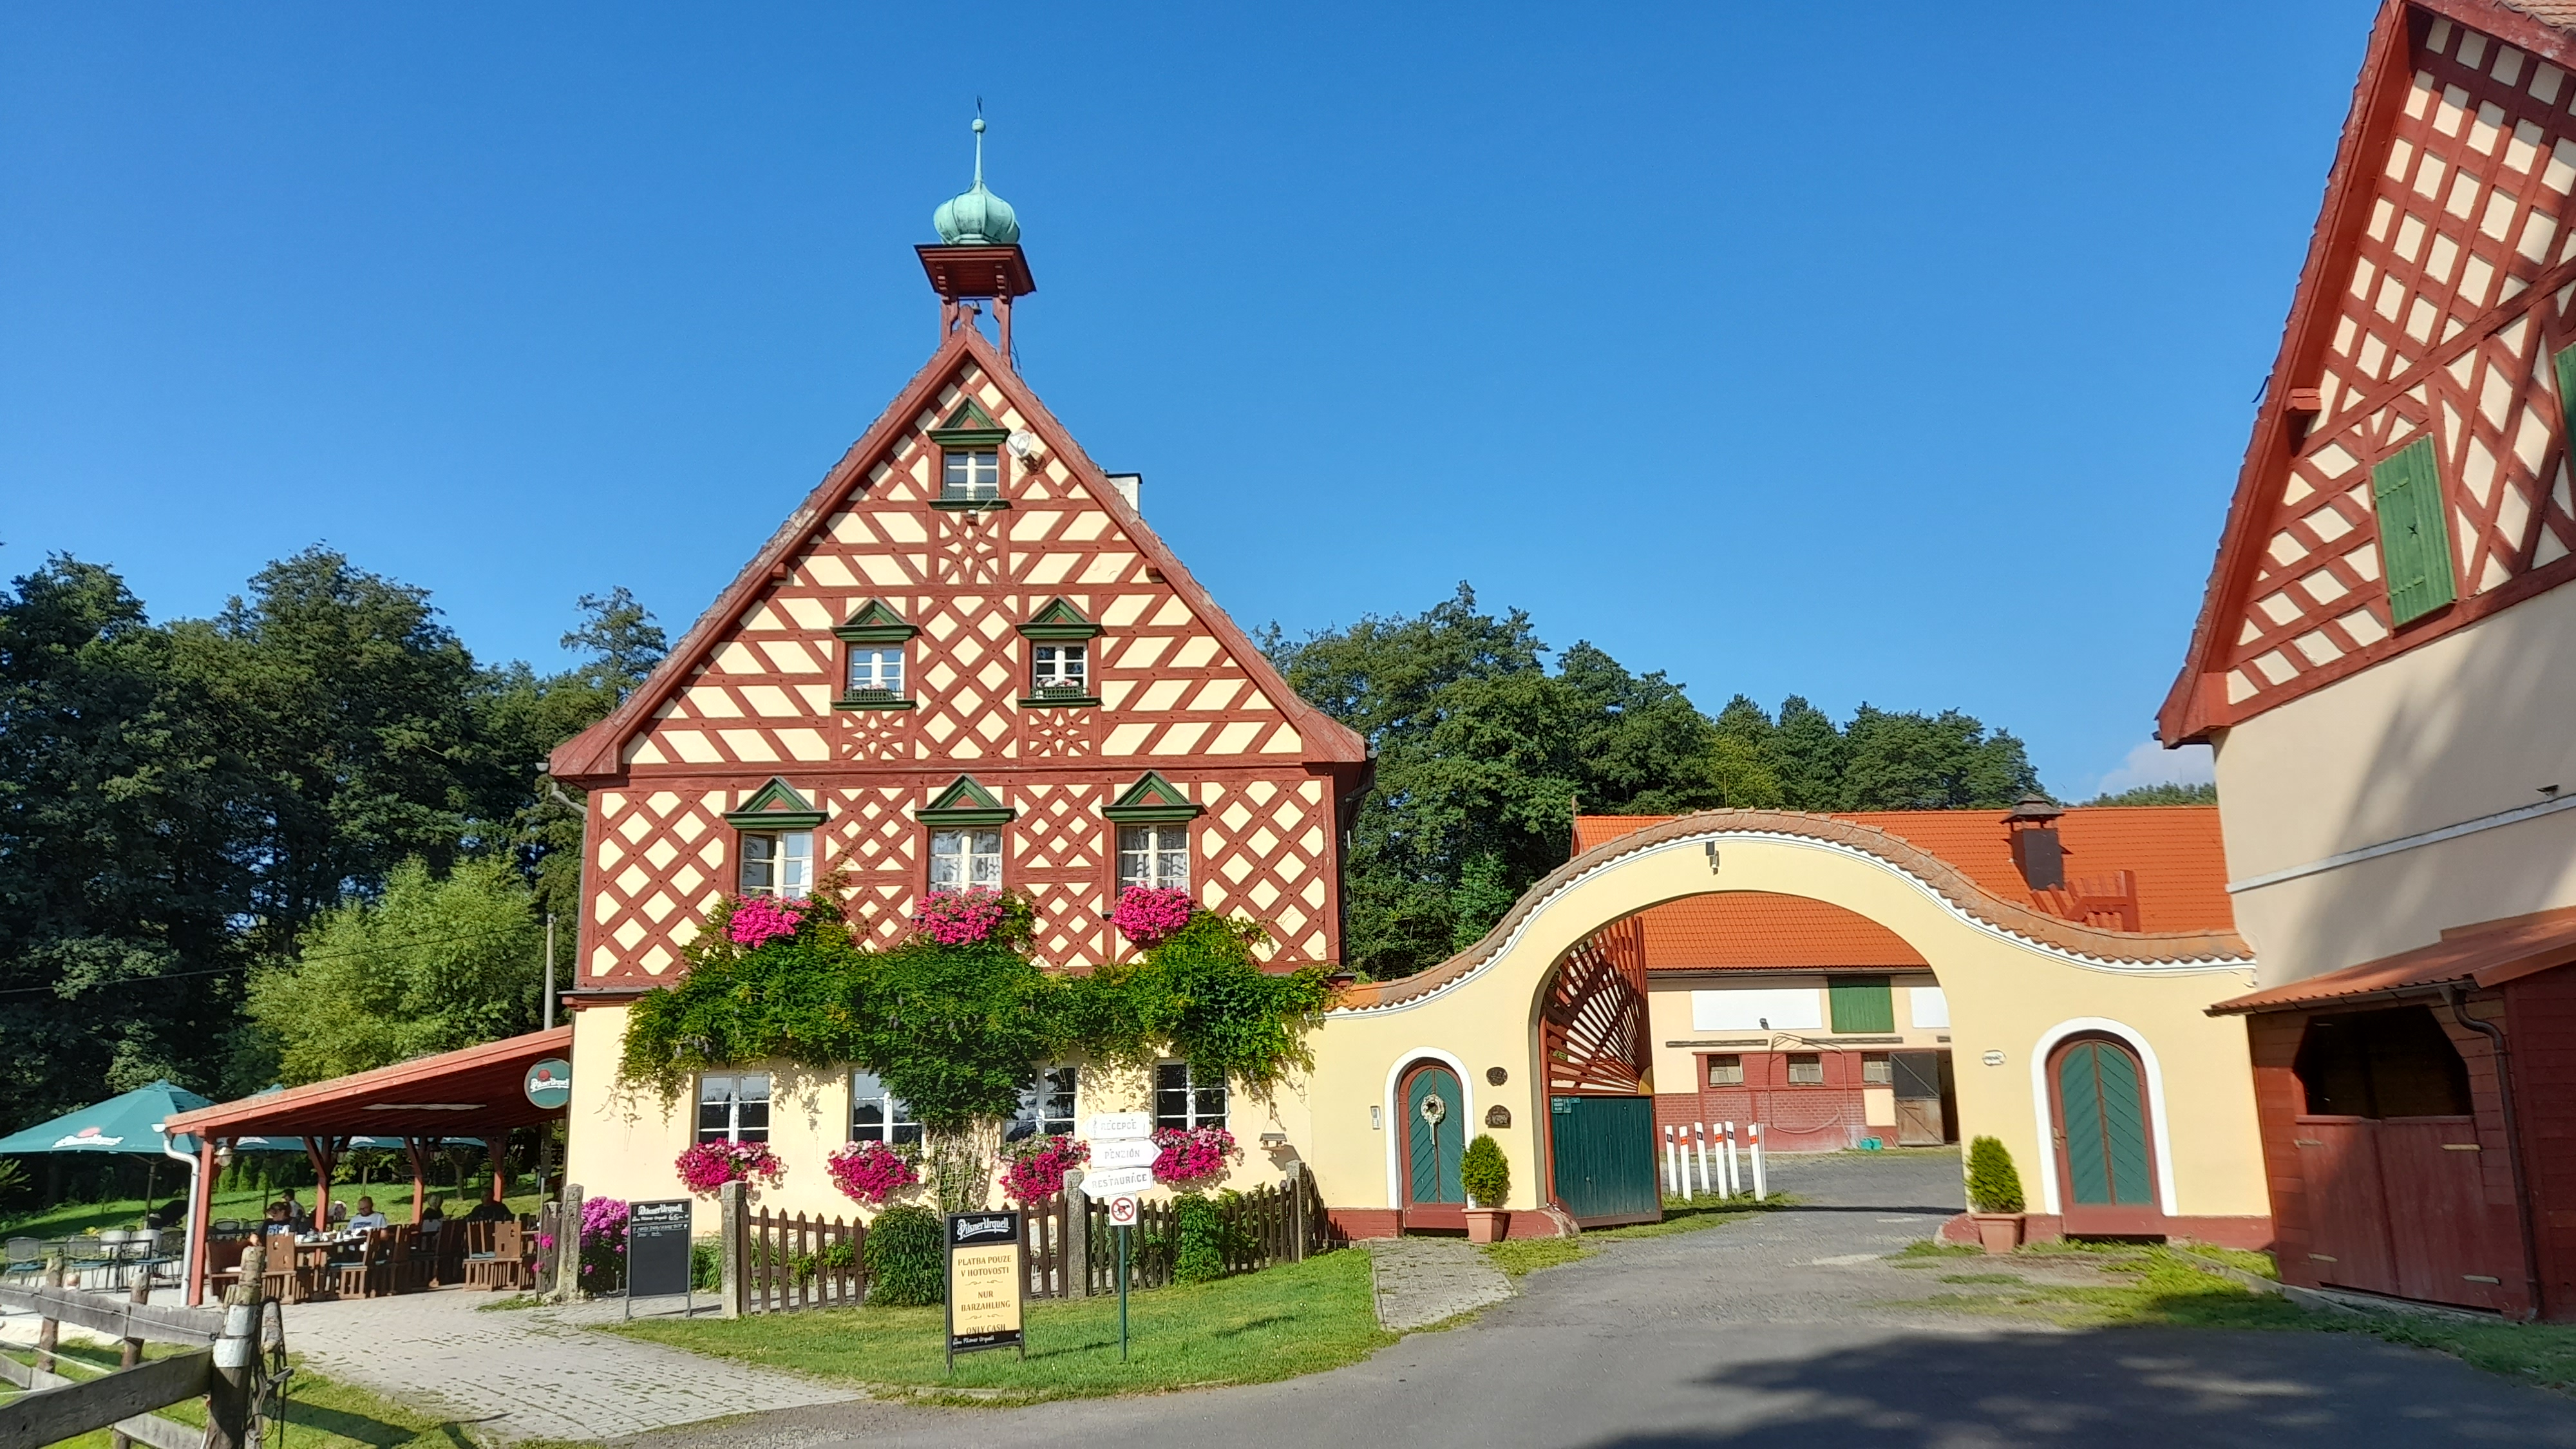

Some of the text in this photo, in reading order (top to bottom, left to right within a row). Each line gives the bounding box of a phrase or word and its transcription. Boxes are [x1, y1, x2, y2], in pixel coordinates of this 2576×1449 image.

[957, 1217, 1010, 1241] Pilsner Urquell
[958, 1255, 1012, 1266] PLATBA POUZE
[967, 1266, 1009, 1277] HOTOVOSTI
[978, 1290, 994, 1299] NUR
[961, 1300, 1010, 1312] BARZAHLUNG
[987, 1323, 1006, 1332] CASH
